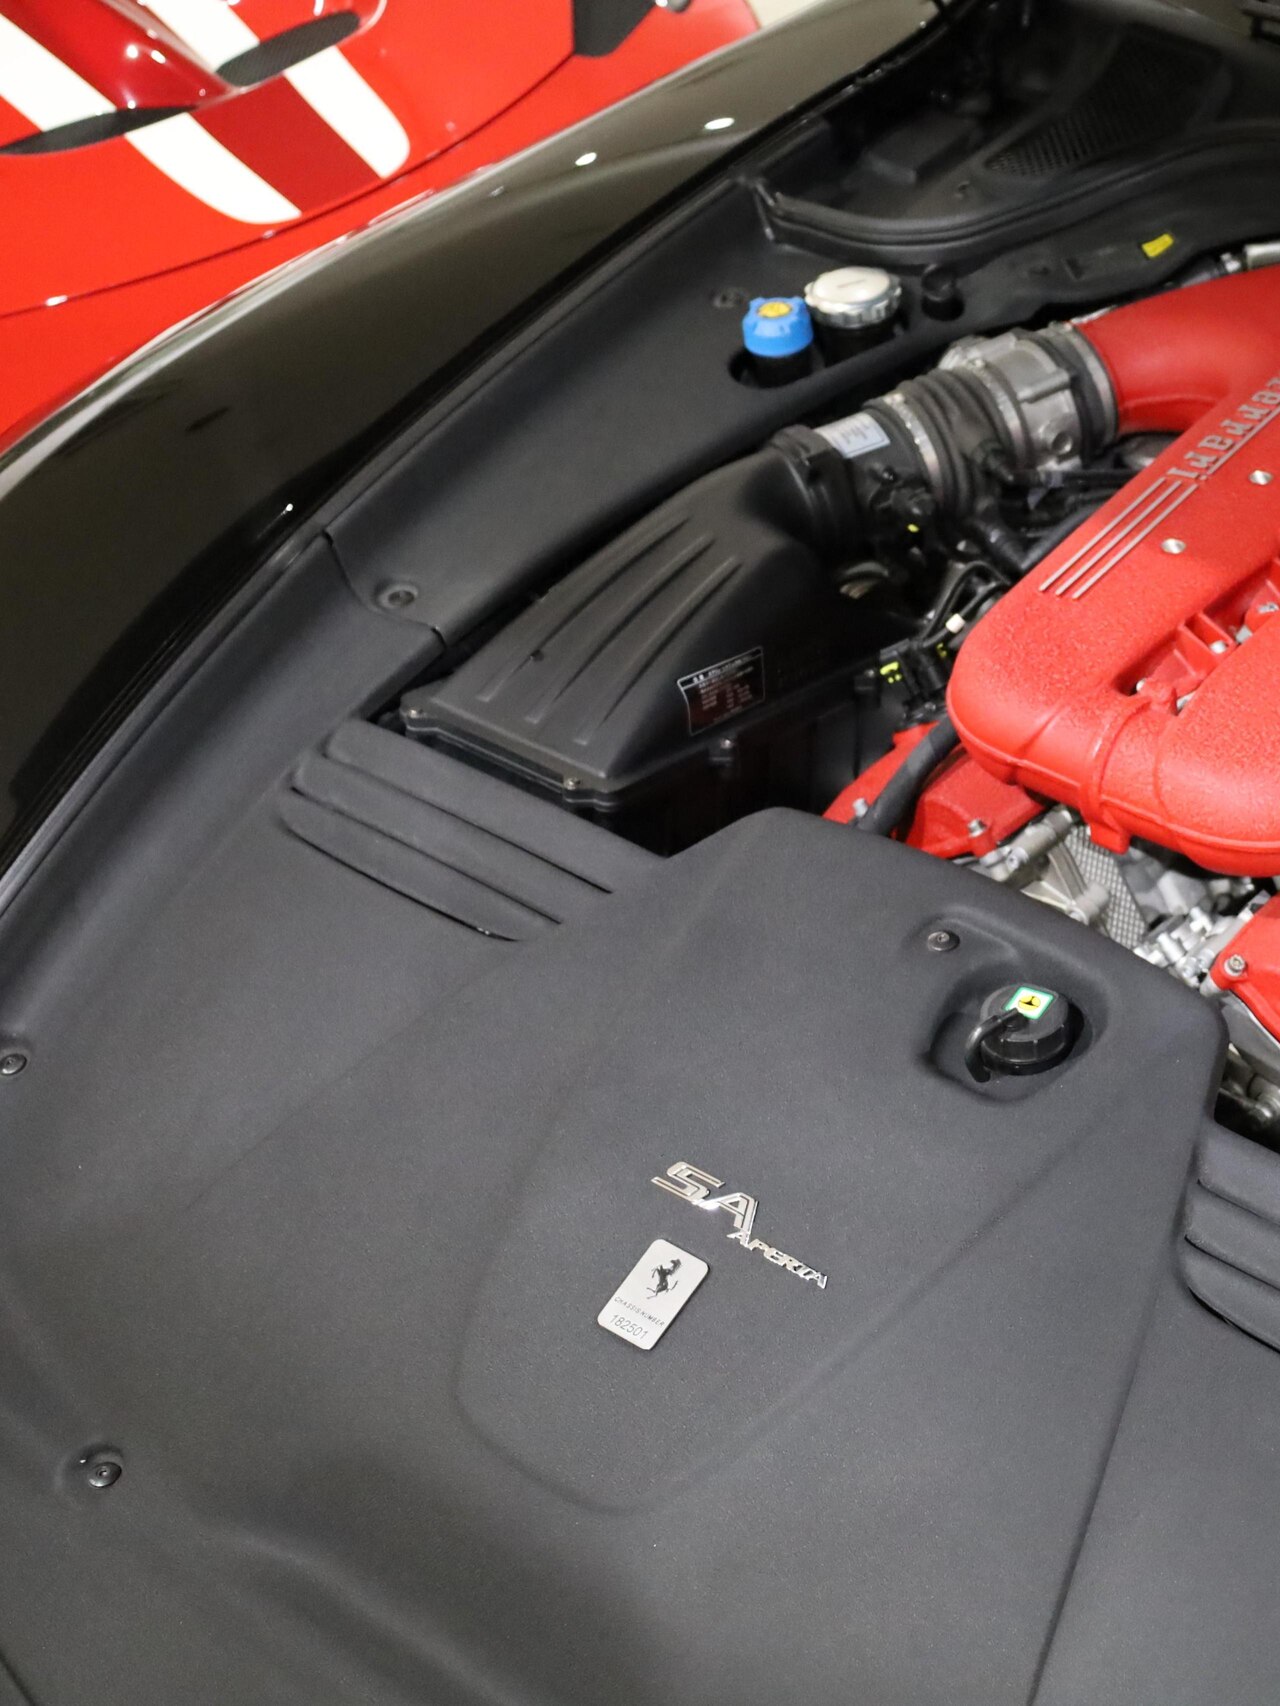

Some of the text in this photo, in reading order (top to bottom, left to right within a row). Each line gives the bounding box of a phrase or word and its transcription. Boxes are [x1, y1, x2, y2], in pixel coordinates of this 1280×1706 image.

[726, 1230, 828, 1290] APERTA
[609, 1314, 649, 1340] 182501
[613, 1296, 666, 1327] CHASSIS NUMBER
